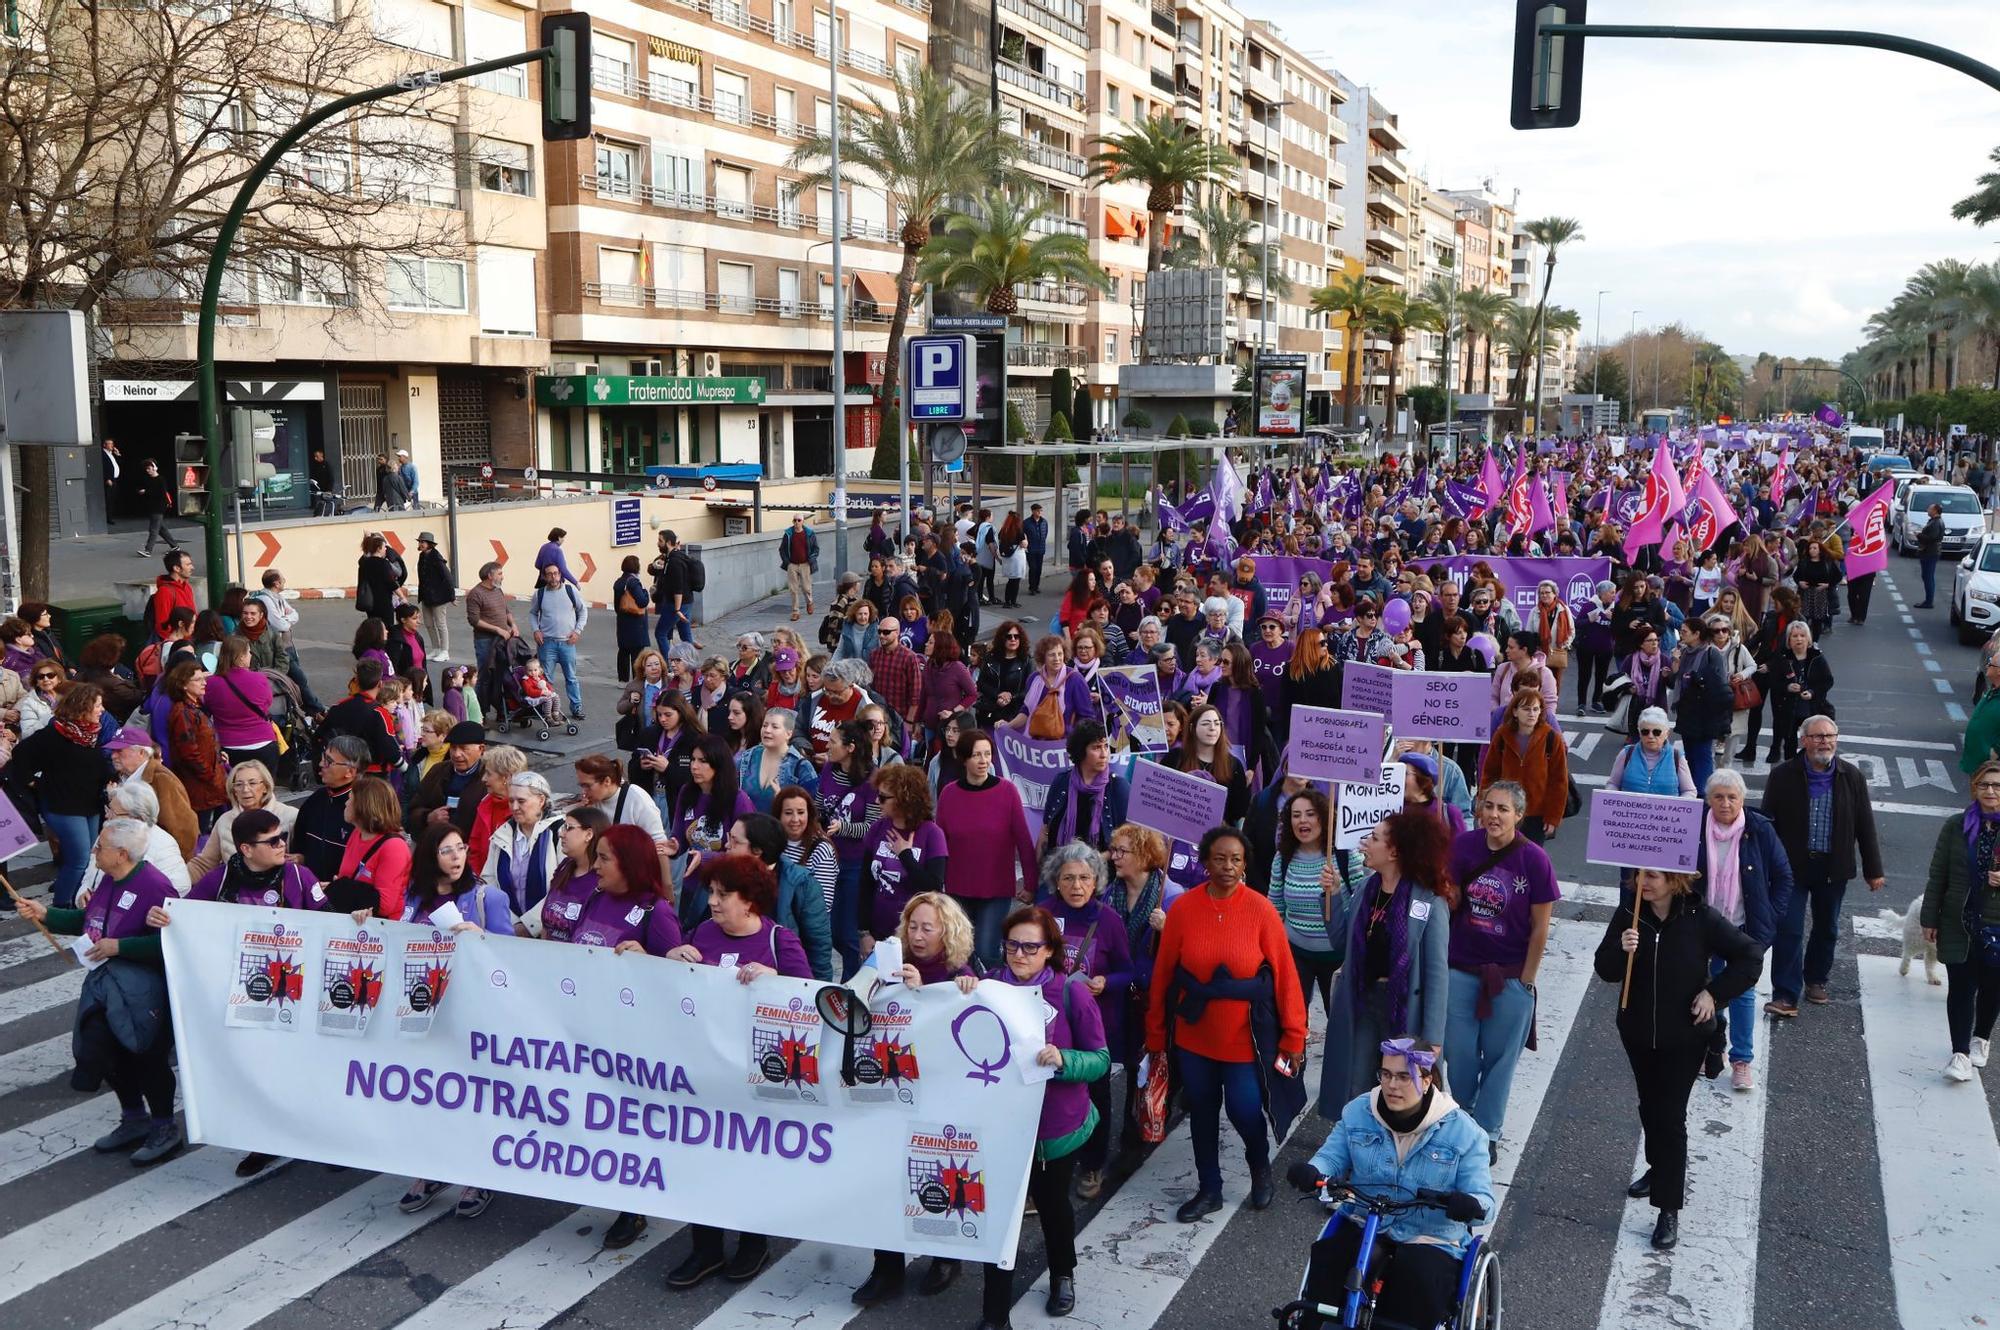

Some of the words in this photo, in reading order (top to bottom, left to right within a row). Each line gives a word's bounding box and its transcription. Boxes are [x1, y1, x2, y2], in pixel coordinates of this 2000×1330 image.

[922, 345, 953, 387] P
[123, 385, 158, 396] Neinor
[411, 386, 420, 397] 21
[628, 380, 692, 400] Fraternidad
[696, 383, 736, 400] Muprespa
[928, 406, 949, 415] LIBRE
[748, 419, 756, 429] 23
[1570, 580, 1591, 599] UGT
[1426, 682, 1458, 692] SEXO
[1124, 695, 1159, 715] SIEMPRE
[1424, 699, 1441, 708] NO
[1445, 699, 1460, 709] ES
[1304, 715, 1313, 723] LA
[1315, 716, 1369, 729] PORNOGRAFÍA
[1412, 712, 1464, 727] GÉNERO.
[1324, 730, 1334, 738] ES
[1336, 731, 1346, 739] LA
[1004, 735, 1075, 769] COLECT
[1301, 740, 1343, 752] PEDAGOGÍA
[1345, 744, 1356, 753] DE
[1358, 746, 1368, 755] LA
[1300, 750, 1358, 766] PROSTITUCIÓN
[1603, 799, 1652, 810] DEFENDEMOS
[1668, 806, 1693, 814] PACTO
[1612, 810, 1648, 820] POLÍTICO
[1603, 819, 1659, 832] ERRADICACIÓN
[1673, 827, 1688, 835] LAS
[1605, 830, 1651, 841] VIOLENCIAS
[1652, 835, 1683, 844] CONTRA
[243, 933, 303, 946] FEMINISMO
[328, 939, 384, 953] FEMINISMO
[406, 942, 457, 953] FEMINISMO
[755, 1006, 820, 1024] FEMINISMO
[870, 1013, 912, 1025] MINISMO
[470, 1031, 696, 1095] PLATAFORMA
[345, 1060, 570, 1126] NOSOTRAS
[584, 1092, 834, 1163] DECIDIMOS
[911, 1135, 978, 1150] FEMINISMO
[958, 1132, 972, 1140] 8M
[492, 1129, 665, 1191] CÓRDOBA
